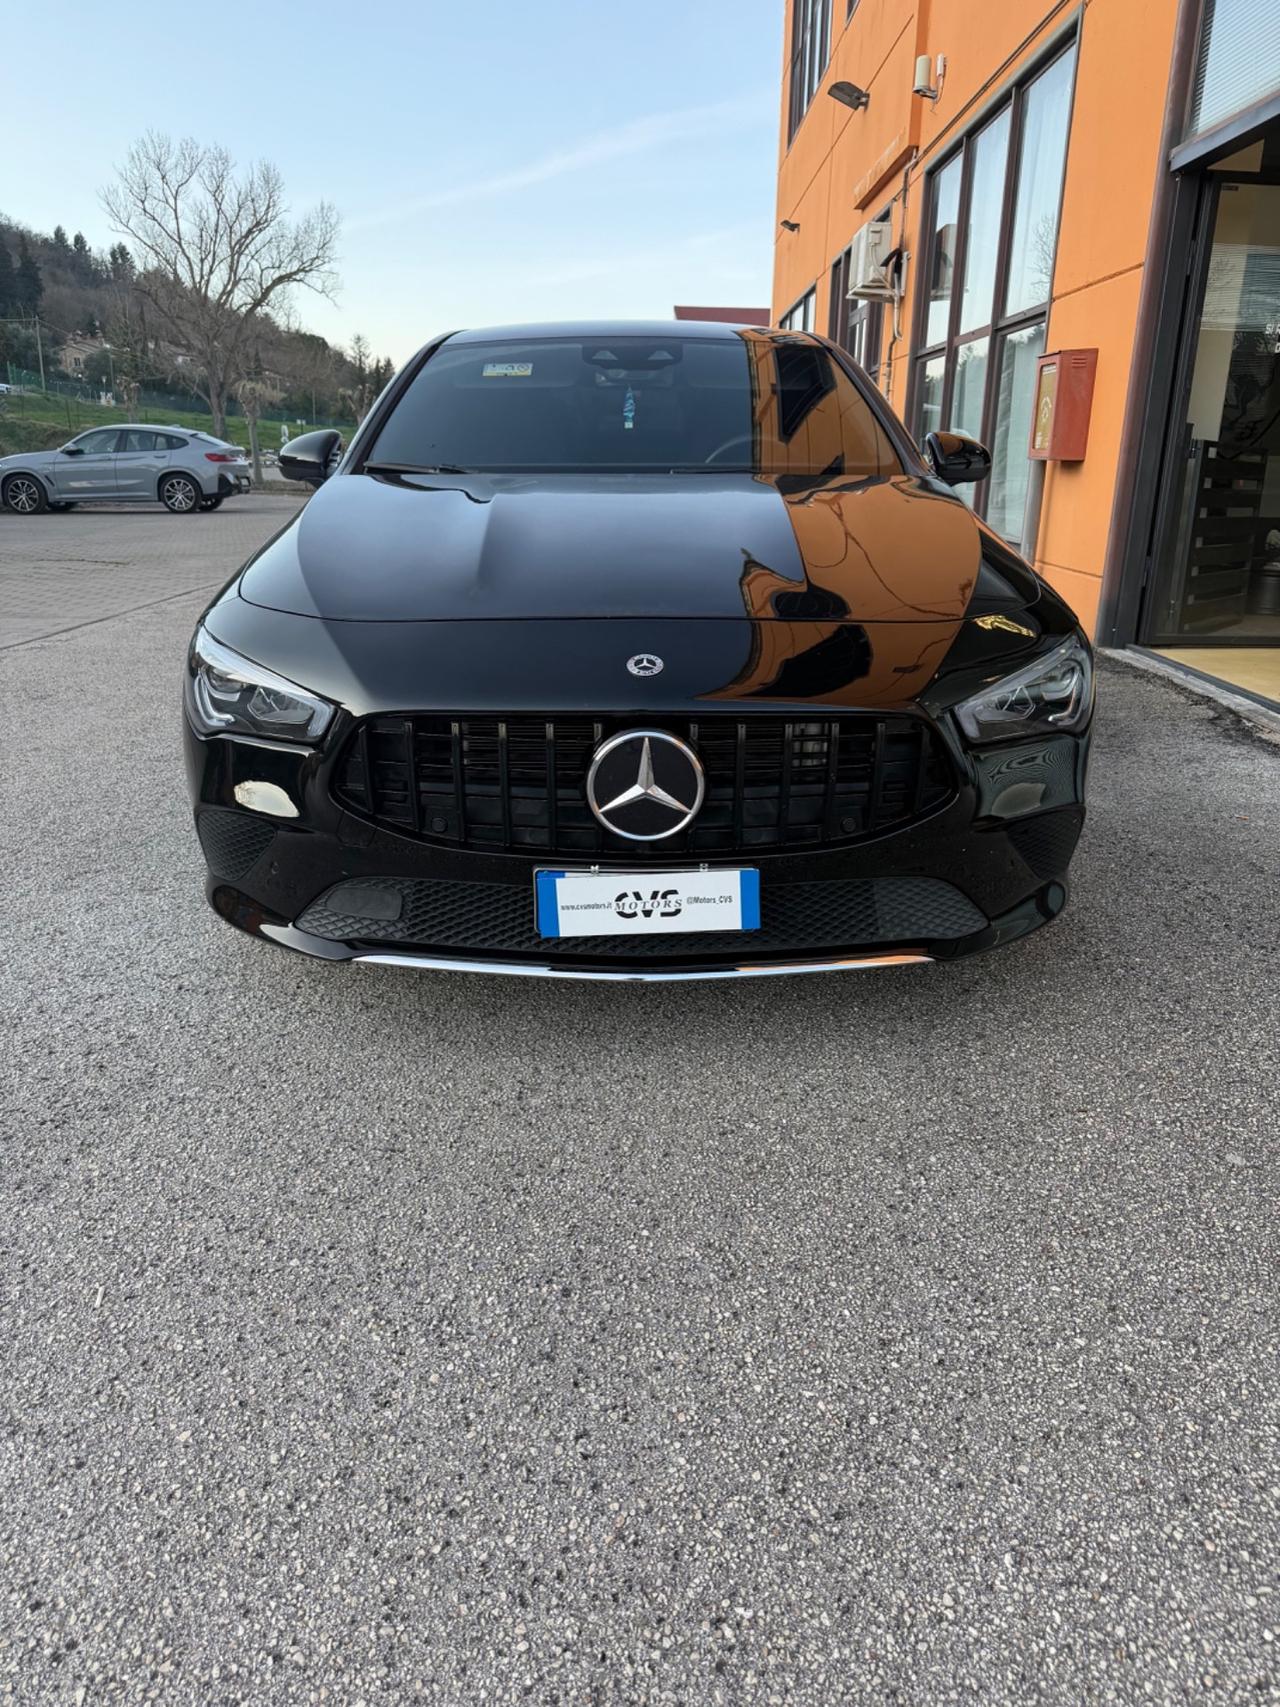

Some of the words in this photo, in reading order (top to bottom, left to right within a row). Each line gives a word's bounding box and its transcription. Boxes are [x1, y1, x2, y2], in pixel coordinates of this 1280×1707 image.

[614, 889, 682, 919] CVS
[614, 898, 682, 911] MOTORS
[686, 895, 733, 905] @Motors_CVS
